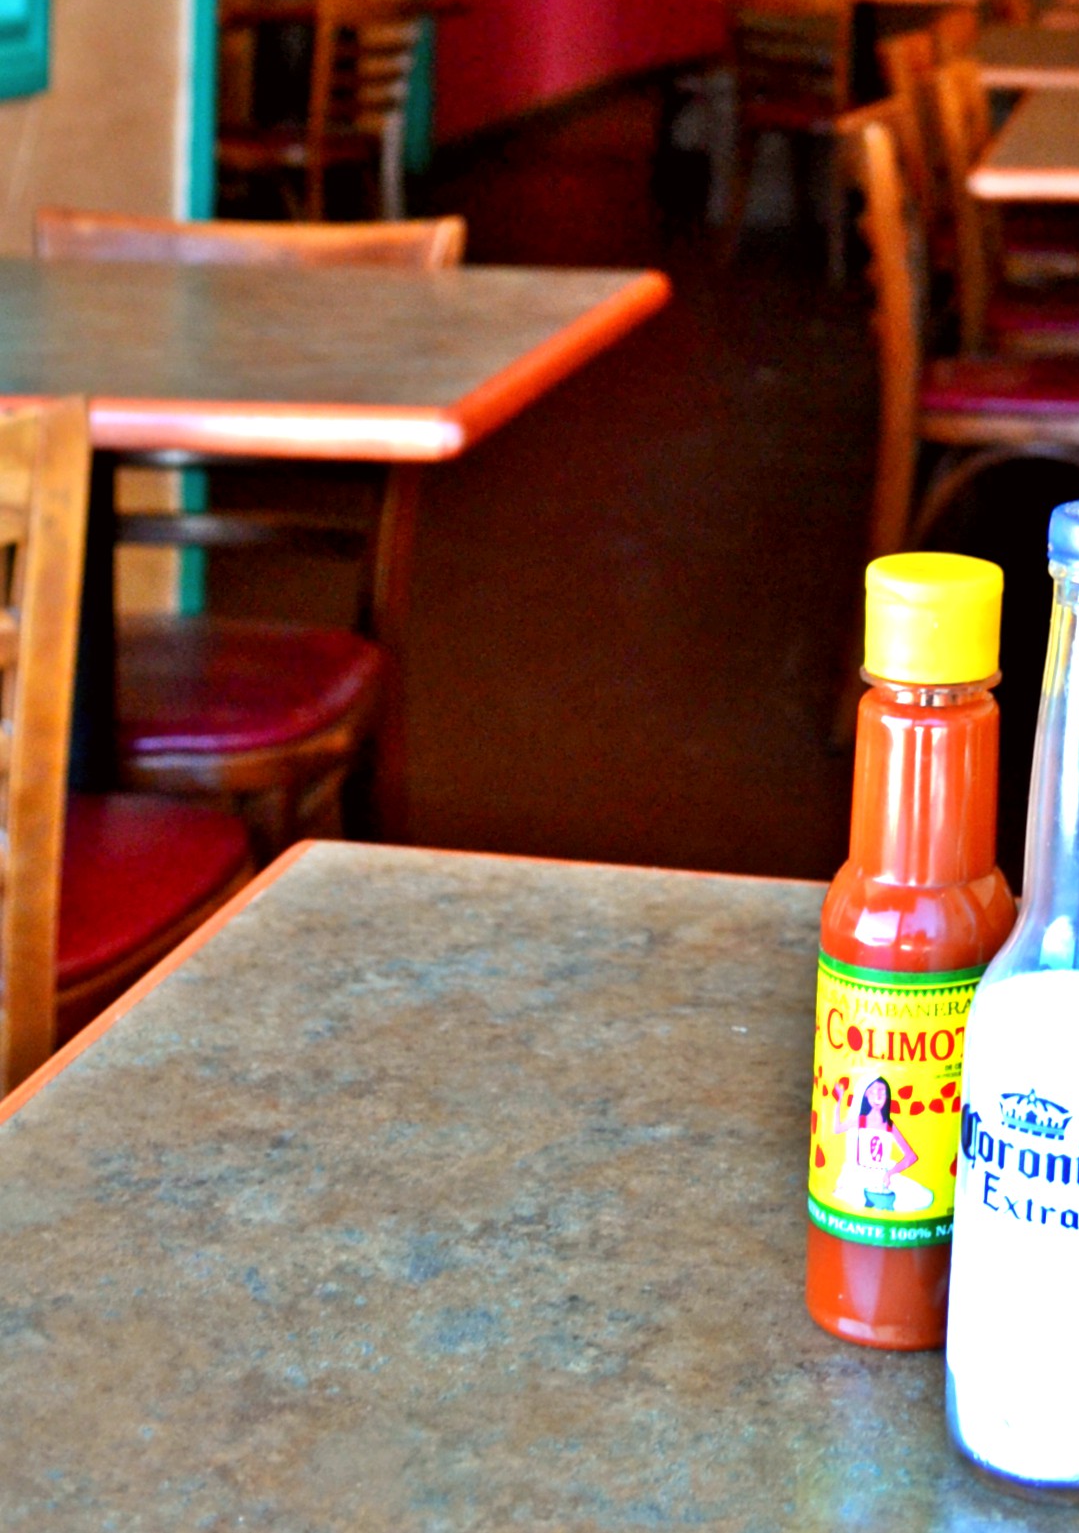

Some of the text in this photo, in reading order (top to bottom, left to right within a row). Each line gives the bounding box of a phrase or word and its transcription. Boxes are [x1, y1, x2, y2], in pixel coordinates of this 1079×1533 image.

[982, 1170, 1079, 1231] Extra
[827, 1214, 885, 1240] PICANTE
[889, 1226, 932, 1241] 100%
